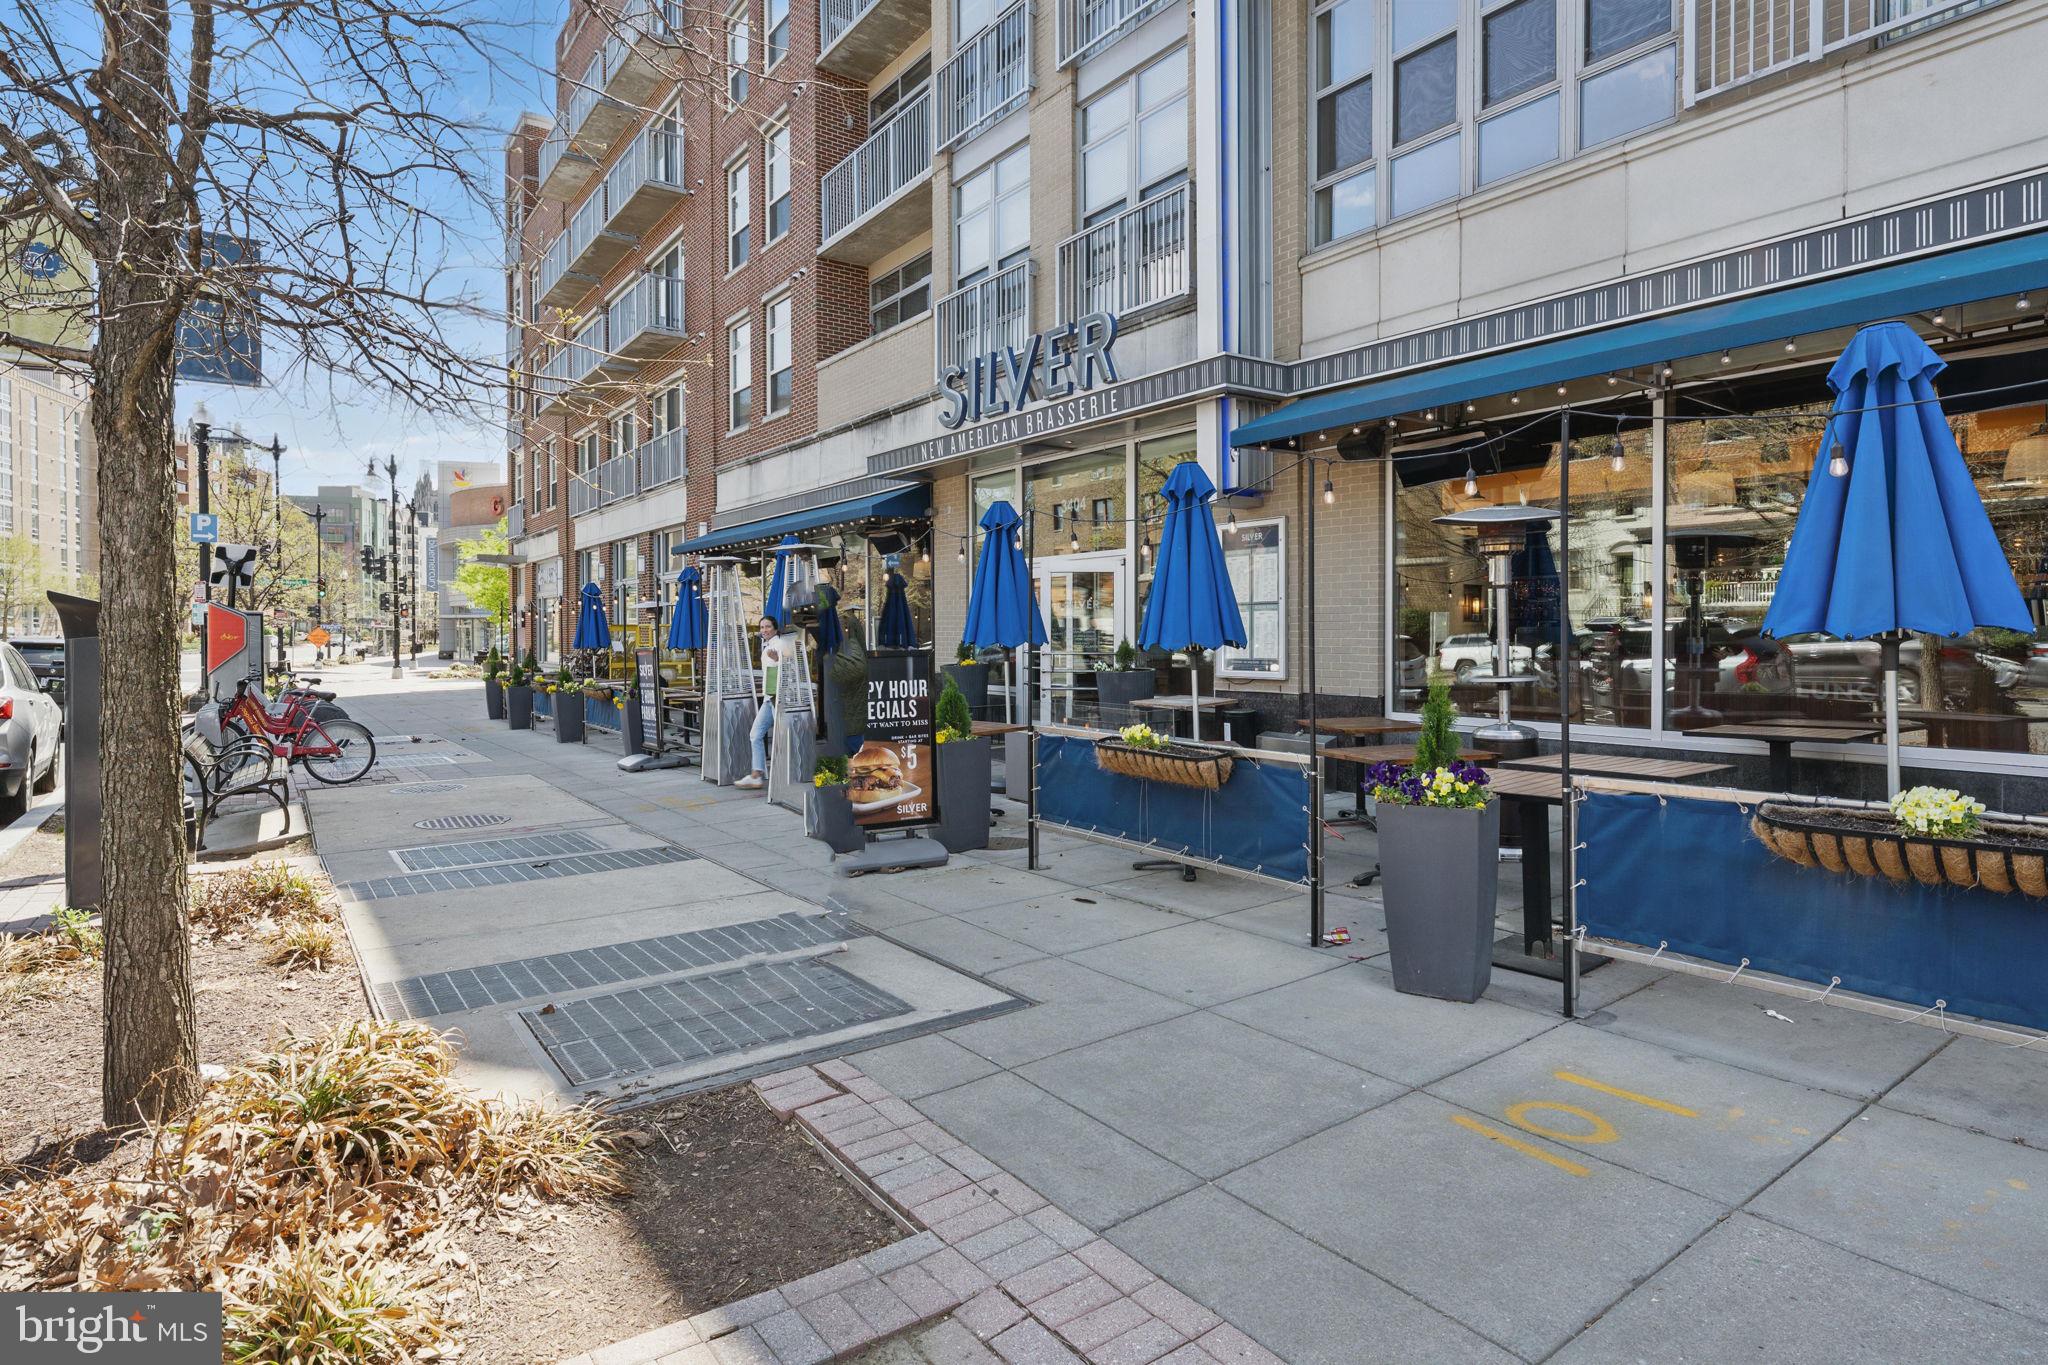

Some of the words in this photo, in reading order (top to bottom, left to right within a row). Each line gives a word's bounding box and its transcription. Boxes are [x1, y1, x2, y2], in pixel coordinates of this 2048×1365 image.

[938, 311, 1118, 430] SILVER
[920, 438, 944, 461] NEW
[950, 418, 1019, 454] AMERICAN
[1026, 389, 1118, 434] BRASSERIE
[1062, 497, 1087, 514] 3404
[197, 516, 211, 531] P
[1241, 532, 1263, 542] SILVER
[428, 540, 438, 589] bluemercury
[639, 663, 654, 678] SILVER
[889, 679, 928, 699] HOUR
[867, 699, 917, 720] ECIALS
[867, 721, 878, 729] N'T
[880, 720, 899, 728] WANT
[900, 719, 911, 727] TO
[912, 718, 929, 726] MISS
[901, 744, 917, 769] $5
[897, 802, 928, 815] SILVER
